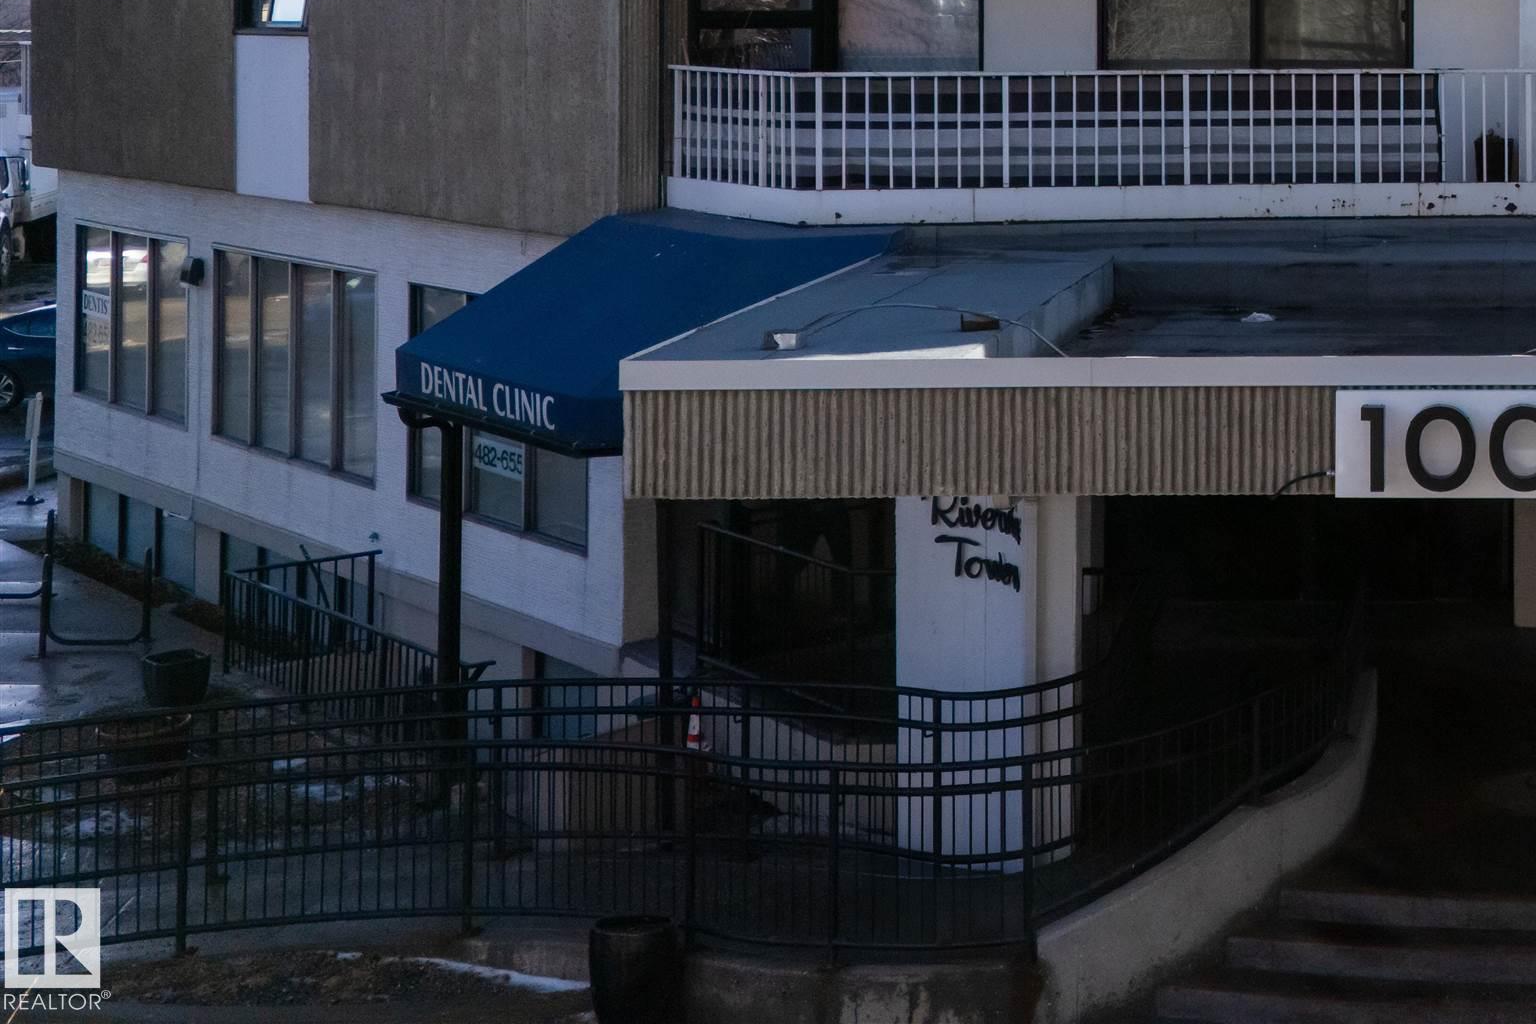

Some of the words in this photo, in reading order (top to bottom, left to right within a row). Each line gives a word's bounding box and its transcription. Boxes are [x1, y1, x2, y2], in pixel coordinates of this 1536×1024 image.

[83, 293, 110, 315] DENTIS
[420, 361, 488, 412] DENTAL
[492, 382, 556, 431] CLINIC
